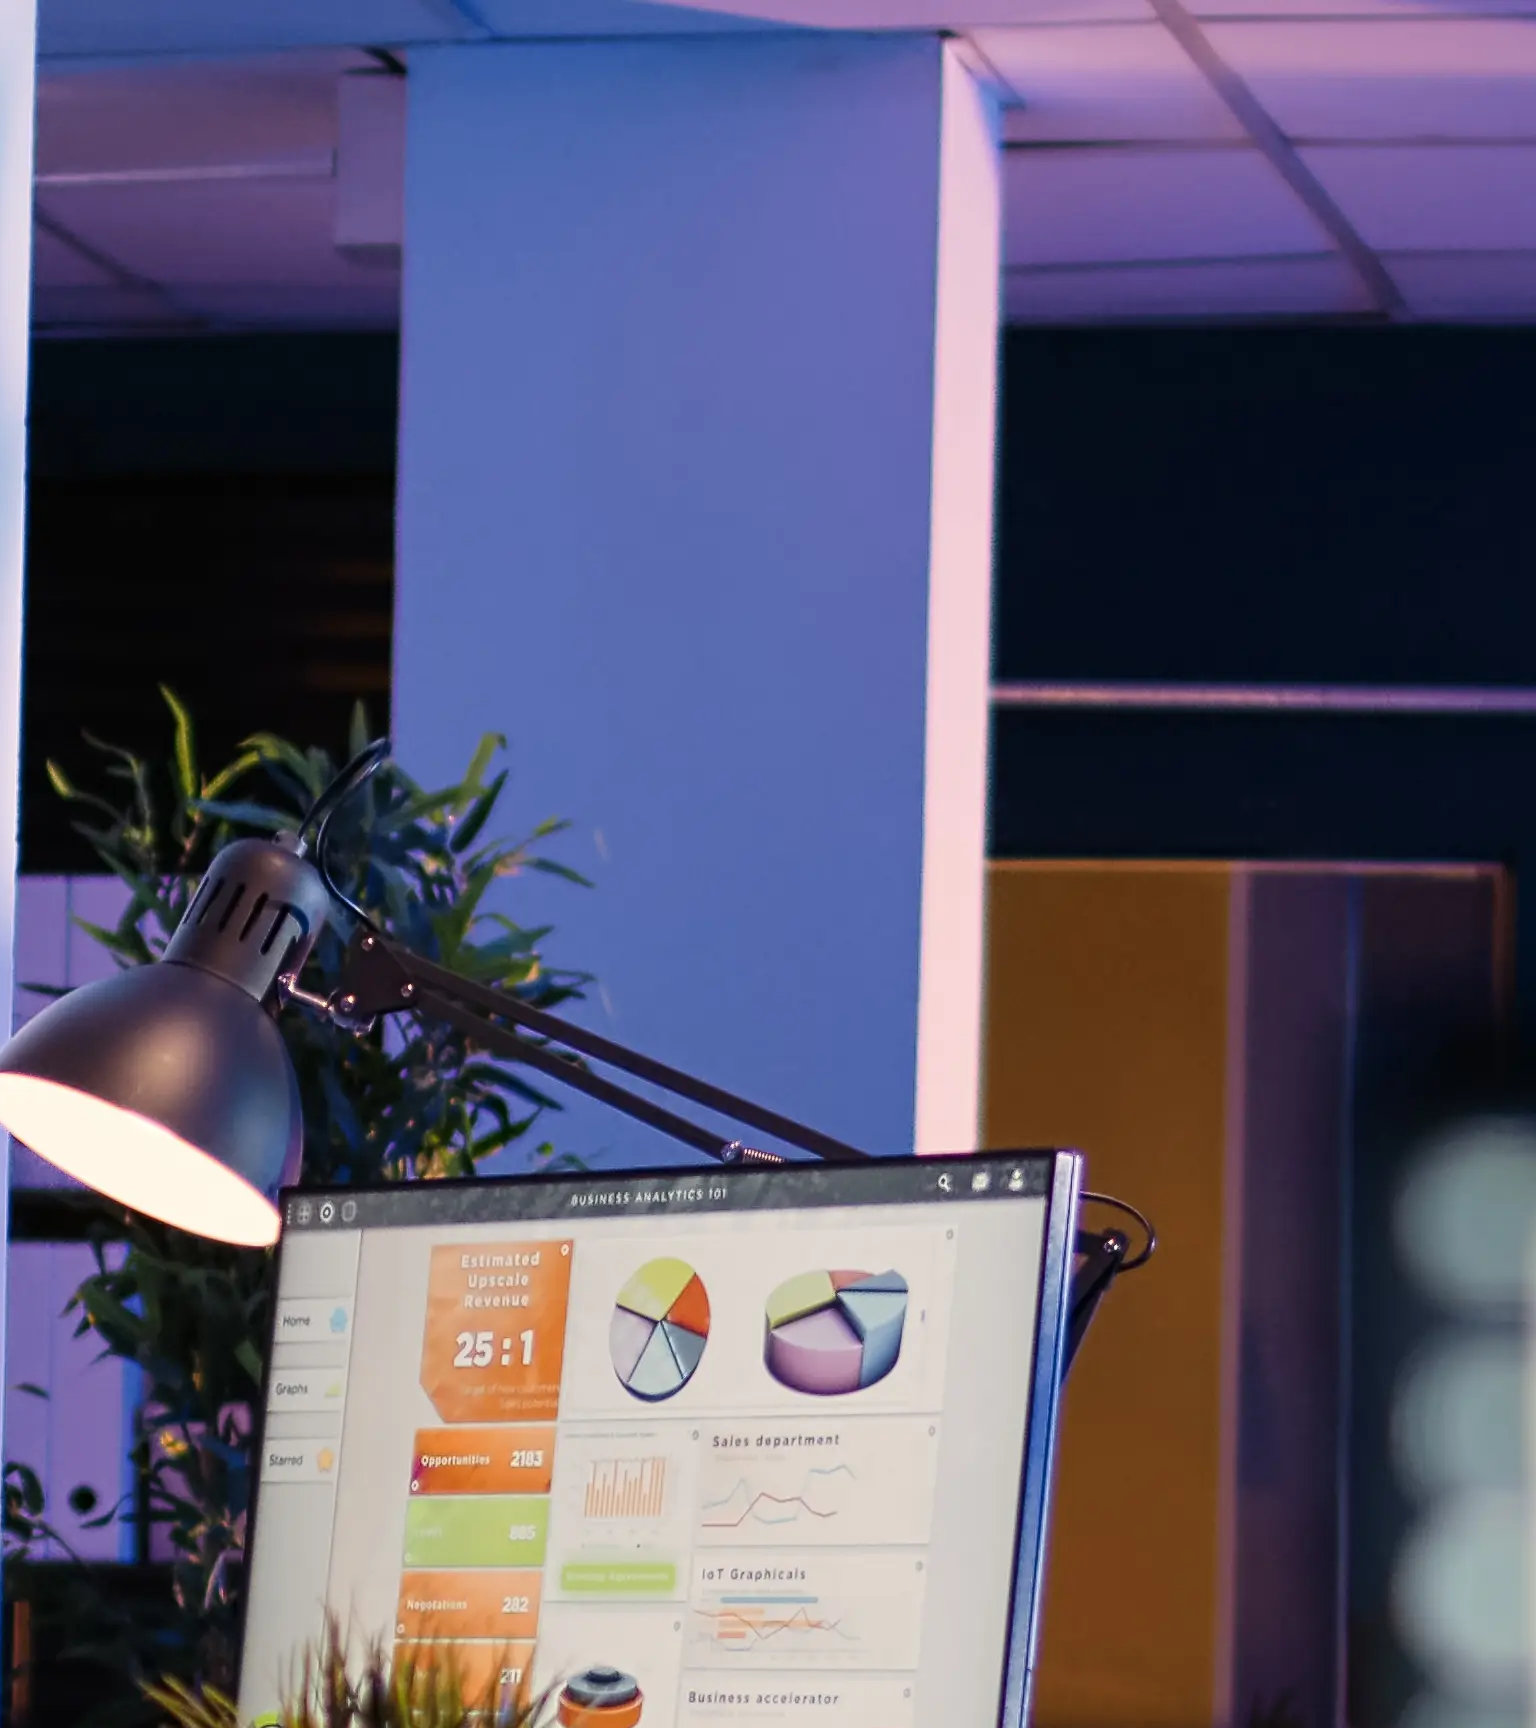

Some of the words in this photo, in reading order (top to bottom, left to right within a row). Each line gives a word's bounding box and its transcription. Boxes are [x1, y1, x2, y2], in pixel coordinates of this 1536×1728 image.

[571, 1192, 629, 1206] BUSINESS
[635, 1189, 703, 1203] ANALYTICS
[709, 1188, 726, 1200] 101
[461, 1252, 540, 1268] Estimated
[468, 1274, 529, 1289] Upscale
[465, 1295, 529, 1308] Revenue
[282, 1315, 310, 1327] Home
[276, 1383, 308, 1396] Graphs
[712, 1435, 749, 1448] Sales
[756, 1434, 839, 1449] department
[269, 1455, 303, 1467] Starred
[421, 1455, 490, 1467] Opportunities
[730, 1567, 806, 1582] Graphicals
[688, 1691, 750, 1703] Business
[756, 1691, 839, 1705] accelerator
